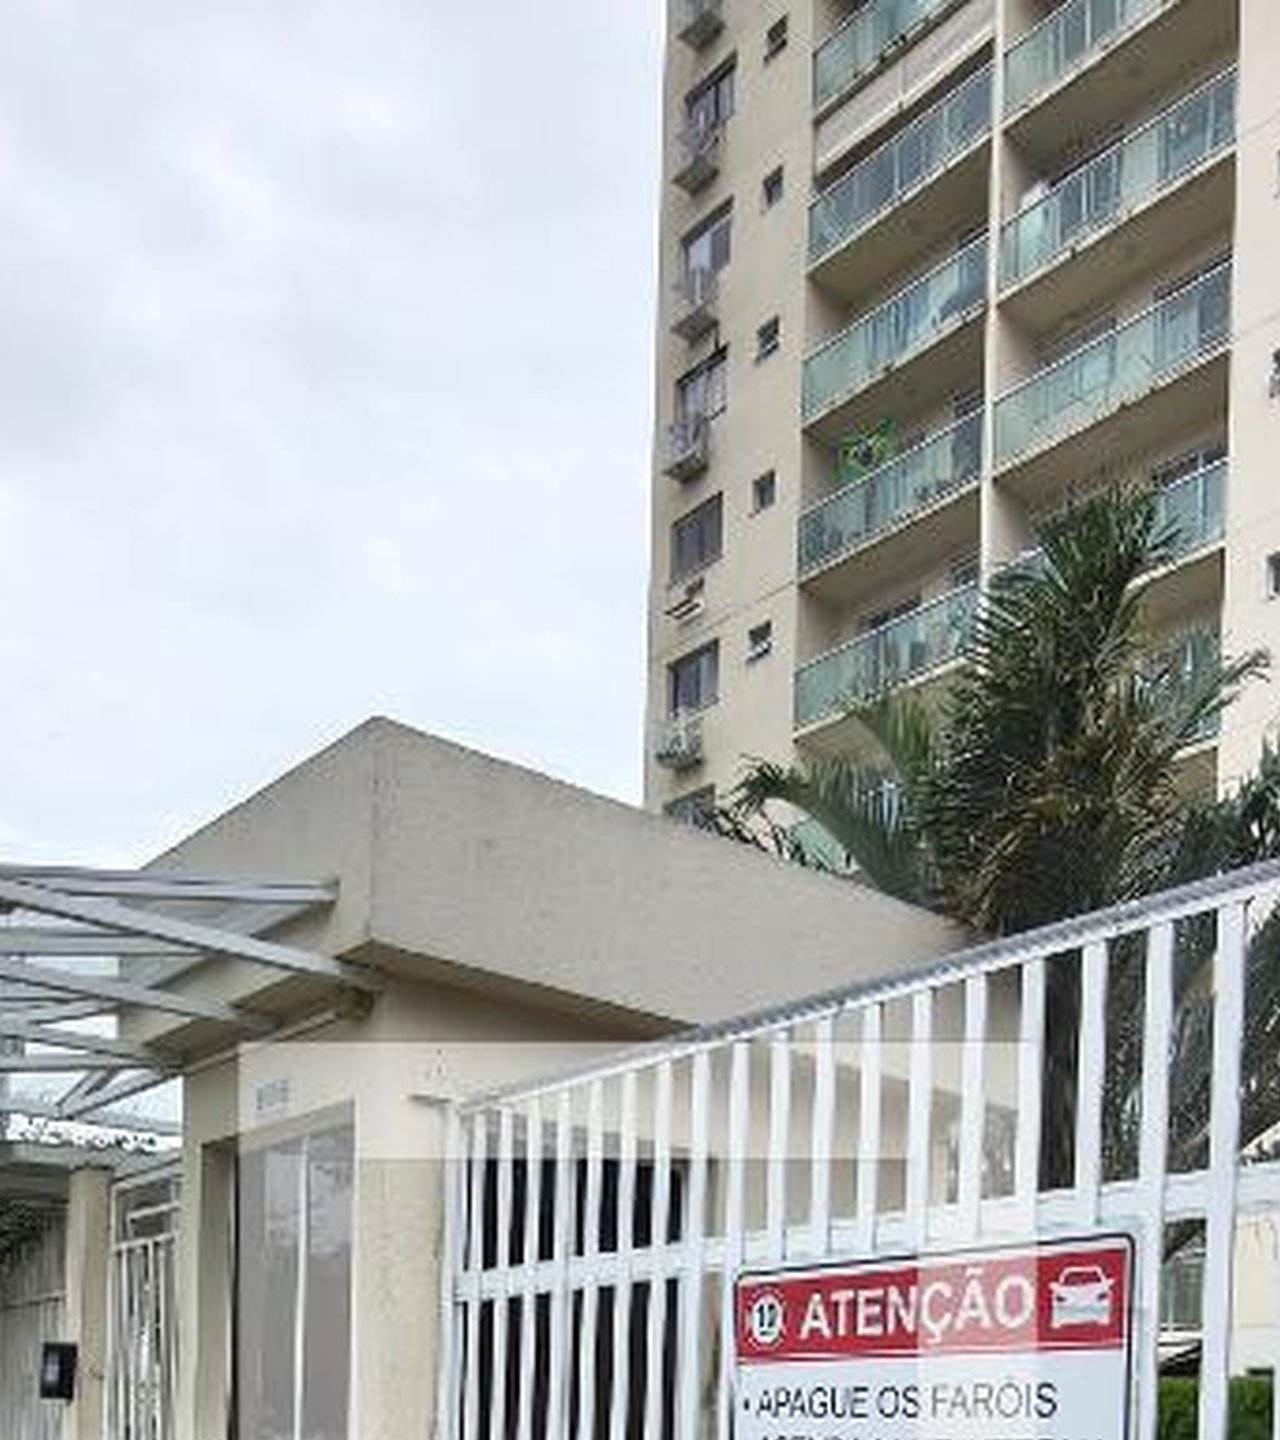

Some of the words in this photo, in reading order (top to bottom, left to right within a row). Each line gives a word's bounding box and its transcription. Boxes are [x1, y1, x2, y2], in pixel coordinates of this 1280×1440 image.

[799, 1267, 1033, 1342] ATENÇÃO
[755, 1386, 870, 1418] APAGUE
[876, 1385, 920, 1418] OS
